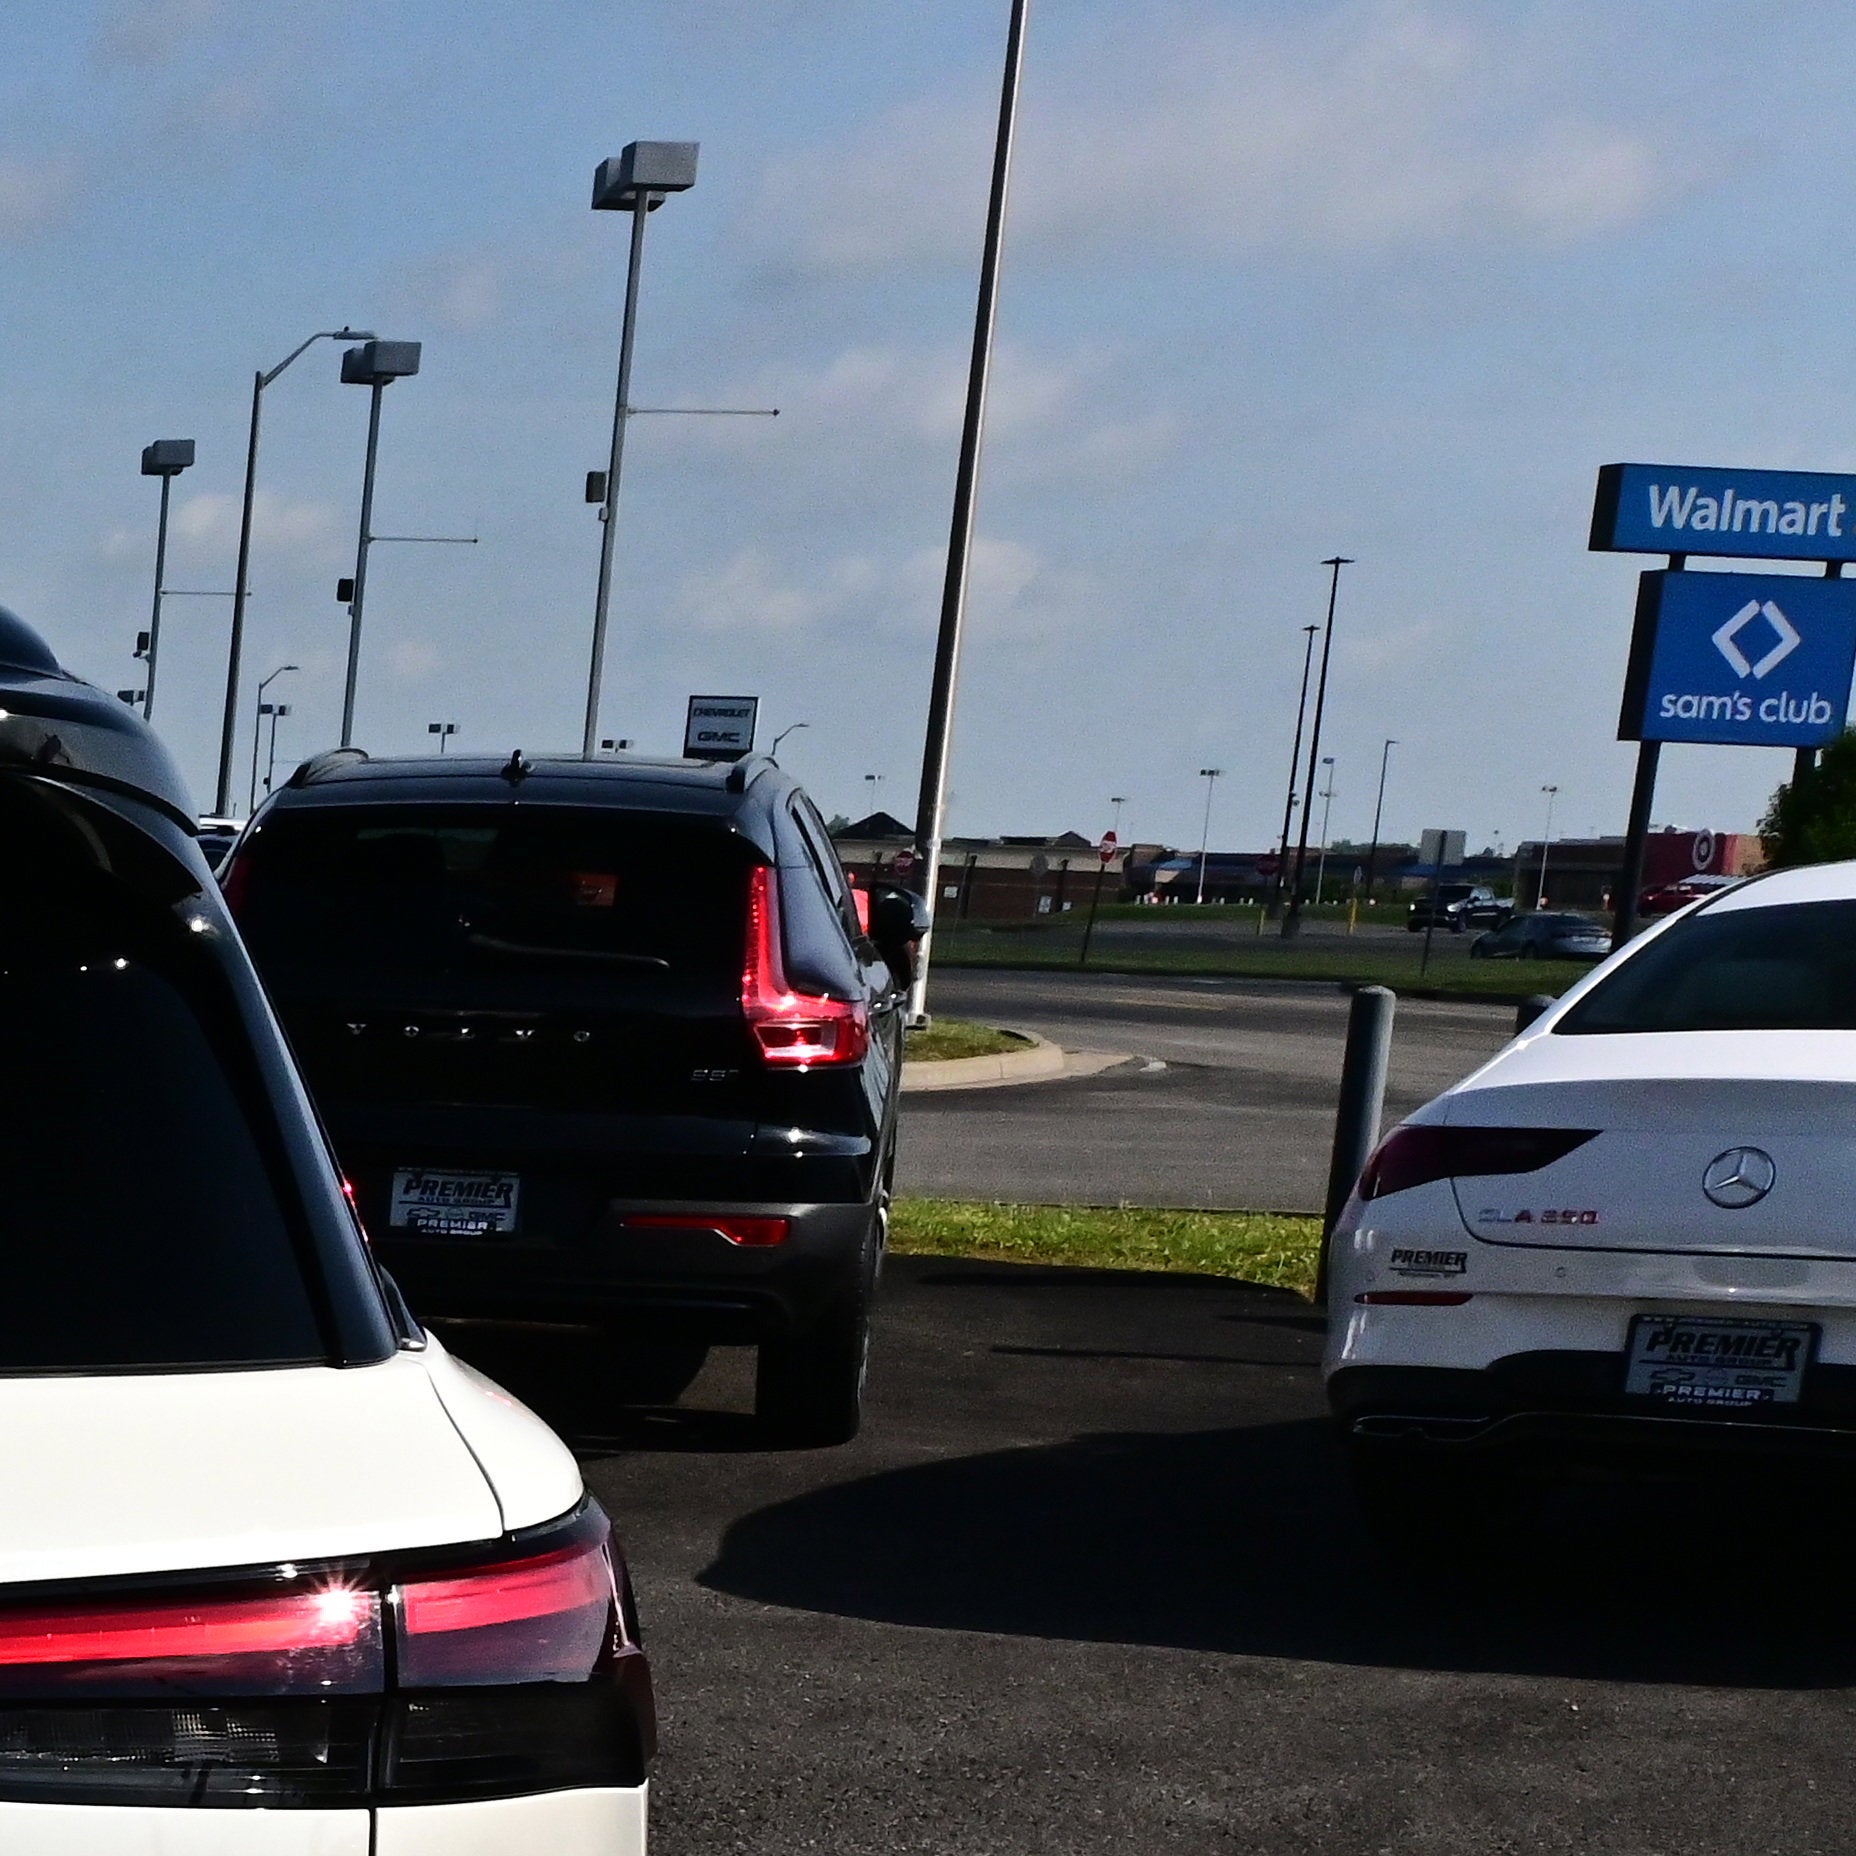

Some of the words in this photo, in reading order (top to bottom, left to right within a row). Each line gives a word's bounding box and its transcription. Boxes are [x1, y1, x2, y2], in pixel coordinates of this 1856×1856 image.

[1648, 484, 1846, 538] Walmart
[693, 708, 751, 718] CHEVROLET
[1660, 689, 1752, 721] sam's
[1759, 690, 1832, 725] club
[697, 731, 741, 743] GMC
[346, 1022, 591, 1043] VOLVO
[403, 1176, 514, 1204] PREMIER
[417, 1219, 489, 1230] PREMIER
[1391, 1248, 1468, 1270] PREMIER
[1646, 1330, 1801, 1365] PREMIER
[1663, 1384, 1762, 1401] PREMIER
